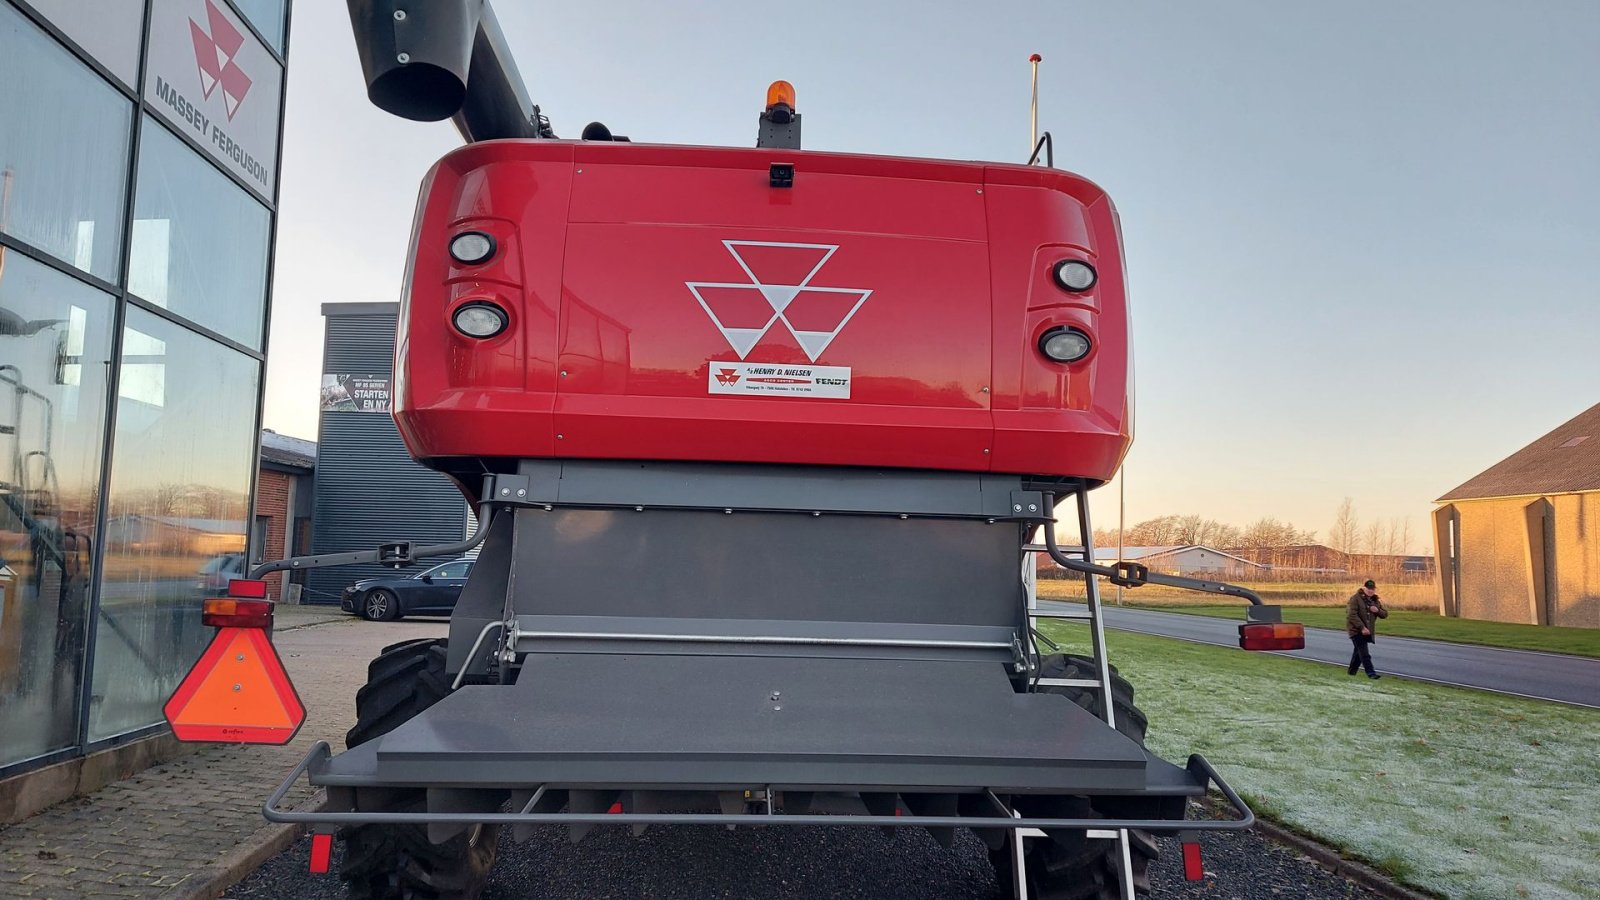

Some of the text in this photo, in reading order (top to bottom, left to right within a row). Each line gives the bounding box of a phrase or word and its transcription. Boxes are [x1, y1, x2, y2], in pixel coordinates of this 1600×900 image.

[156, 75, 268, 186] MASSEY FERGUSON
[354, 389, 389, 399] STARTEN
[364, 400, 387, 409] EN NY
